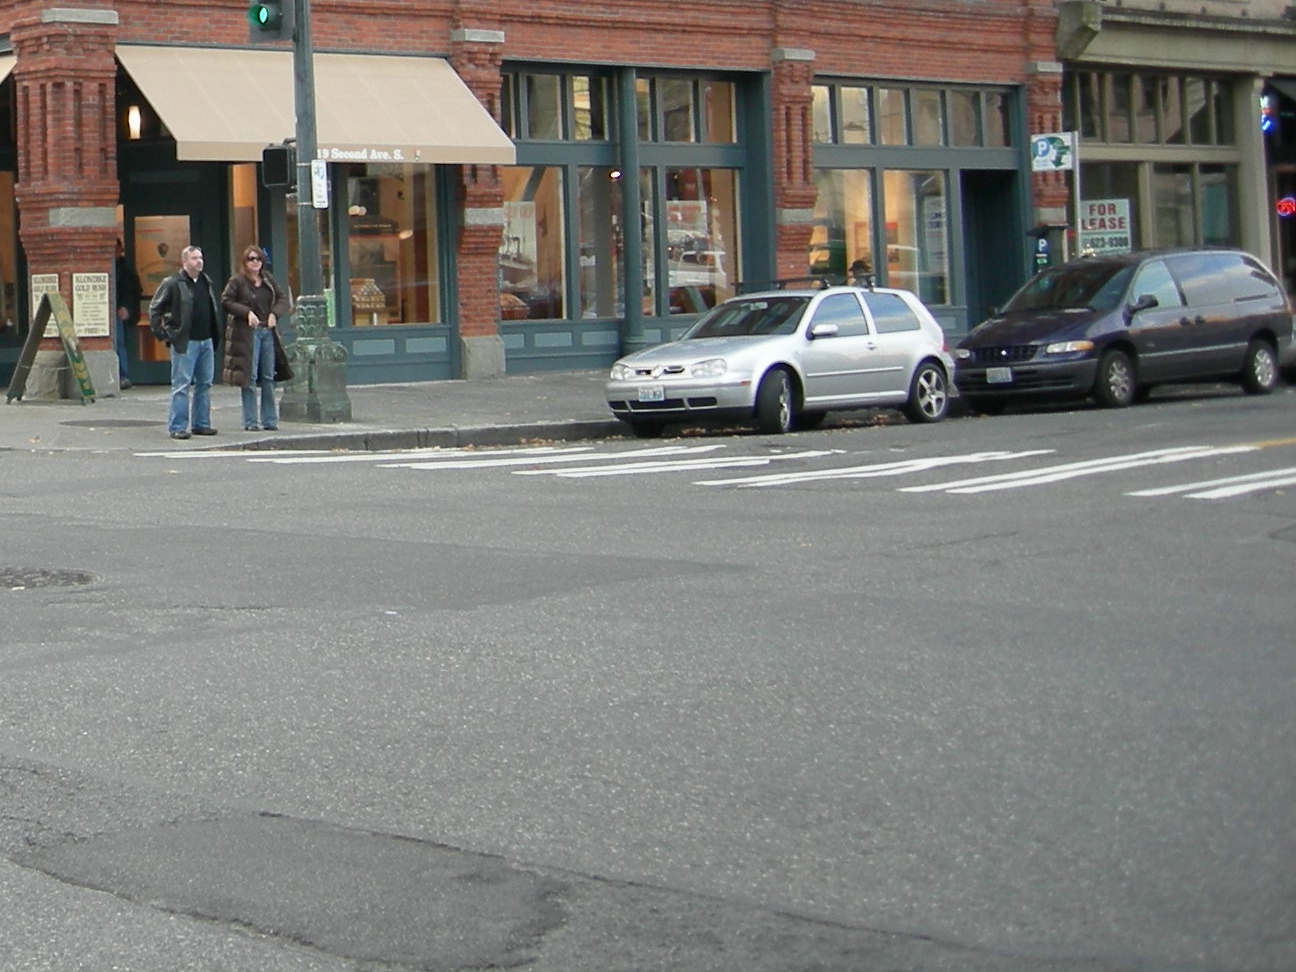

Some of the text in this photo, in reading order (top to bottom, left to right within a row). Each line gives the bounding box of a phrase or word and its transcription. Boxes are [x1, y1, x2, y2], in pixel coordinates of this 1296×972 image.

[331, 147, 367, 159] Second
[369, 149, 392, 159] Ave.
[394, 149, 404, 160] S.
[1088, 203, 1116, 216] FOR
[1081, 217, 1126, 230] LEASE
